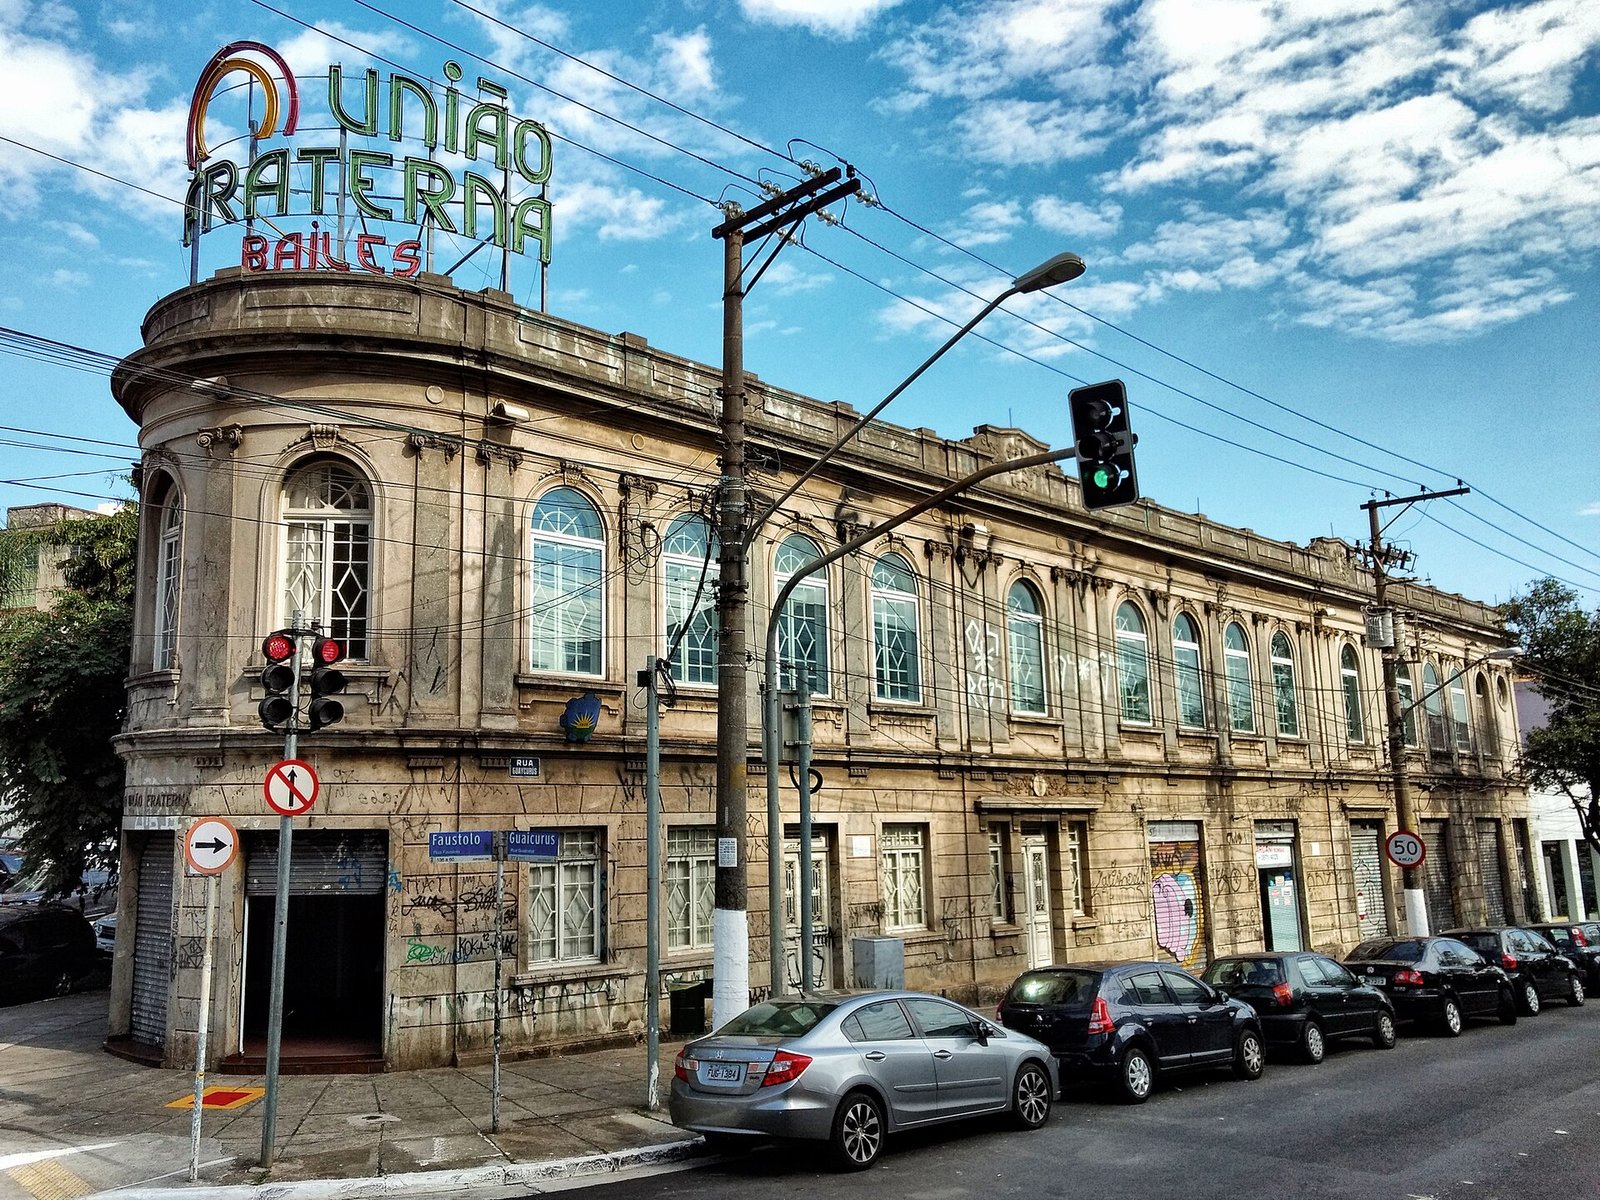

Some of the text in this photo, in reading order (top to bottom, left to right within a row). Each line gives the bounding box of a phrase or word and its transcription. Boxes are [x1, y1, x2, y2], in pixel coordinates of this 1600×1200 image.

[327, 60, 552, 184] UNIÃO
[183, 147, 553, 264] FRATERNA
[242, 221, 421, 277] BAILES
[516, 759, 534, 767] RUA
[432, 833, 480, 846] Faustolo
[509, 832, 556, 845] Guaicurus
[1394, 840, 1418, 856] 50
